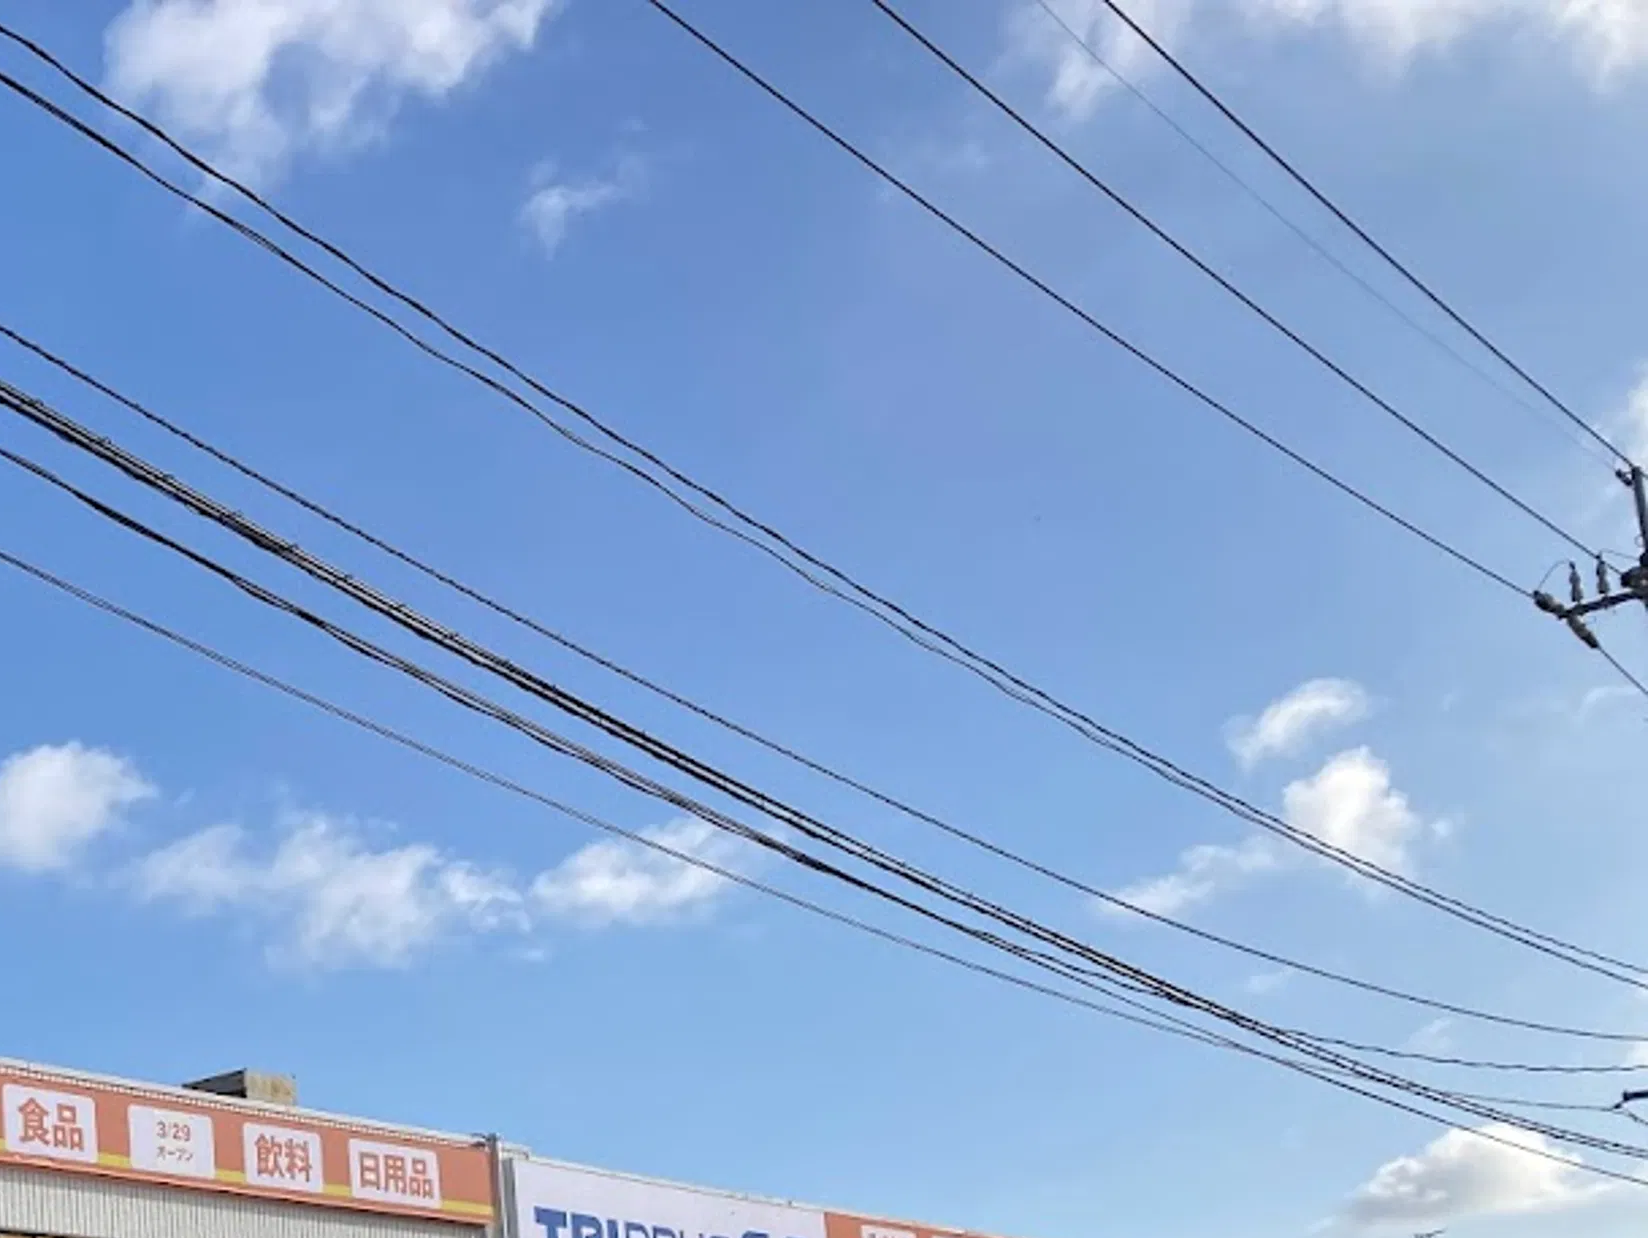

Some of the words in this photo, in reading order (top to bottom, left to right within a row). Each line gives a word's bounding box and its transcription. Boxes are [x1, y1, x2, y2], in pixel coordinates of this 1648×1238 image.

[17, 1096, 86, 1152] 食品
[253, 1131, 313, 1184] 飲料
[358, 1150, 435, 1200] 日用品
